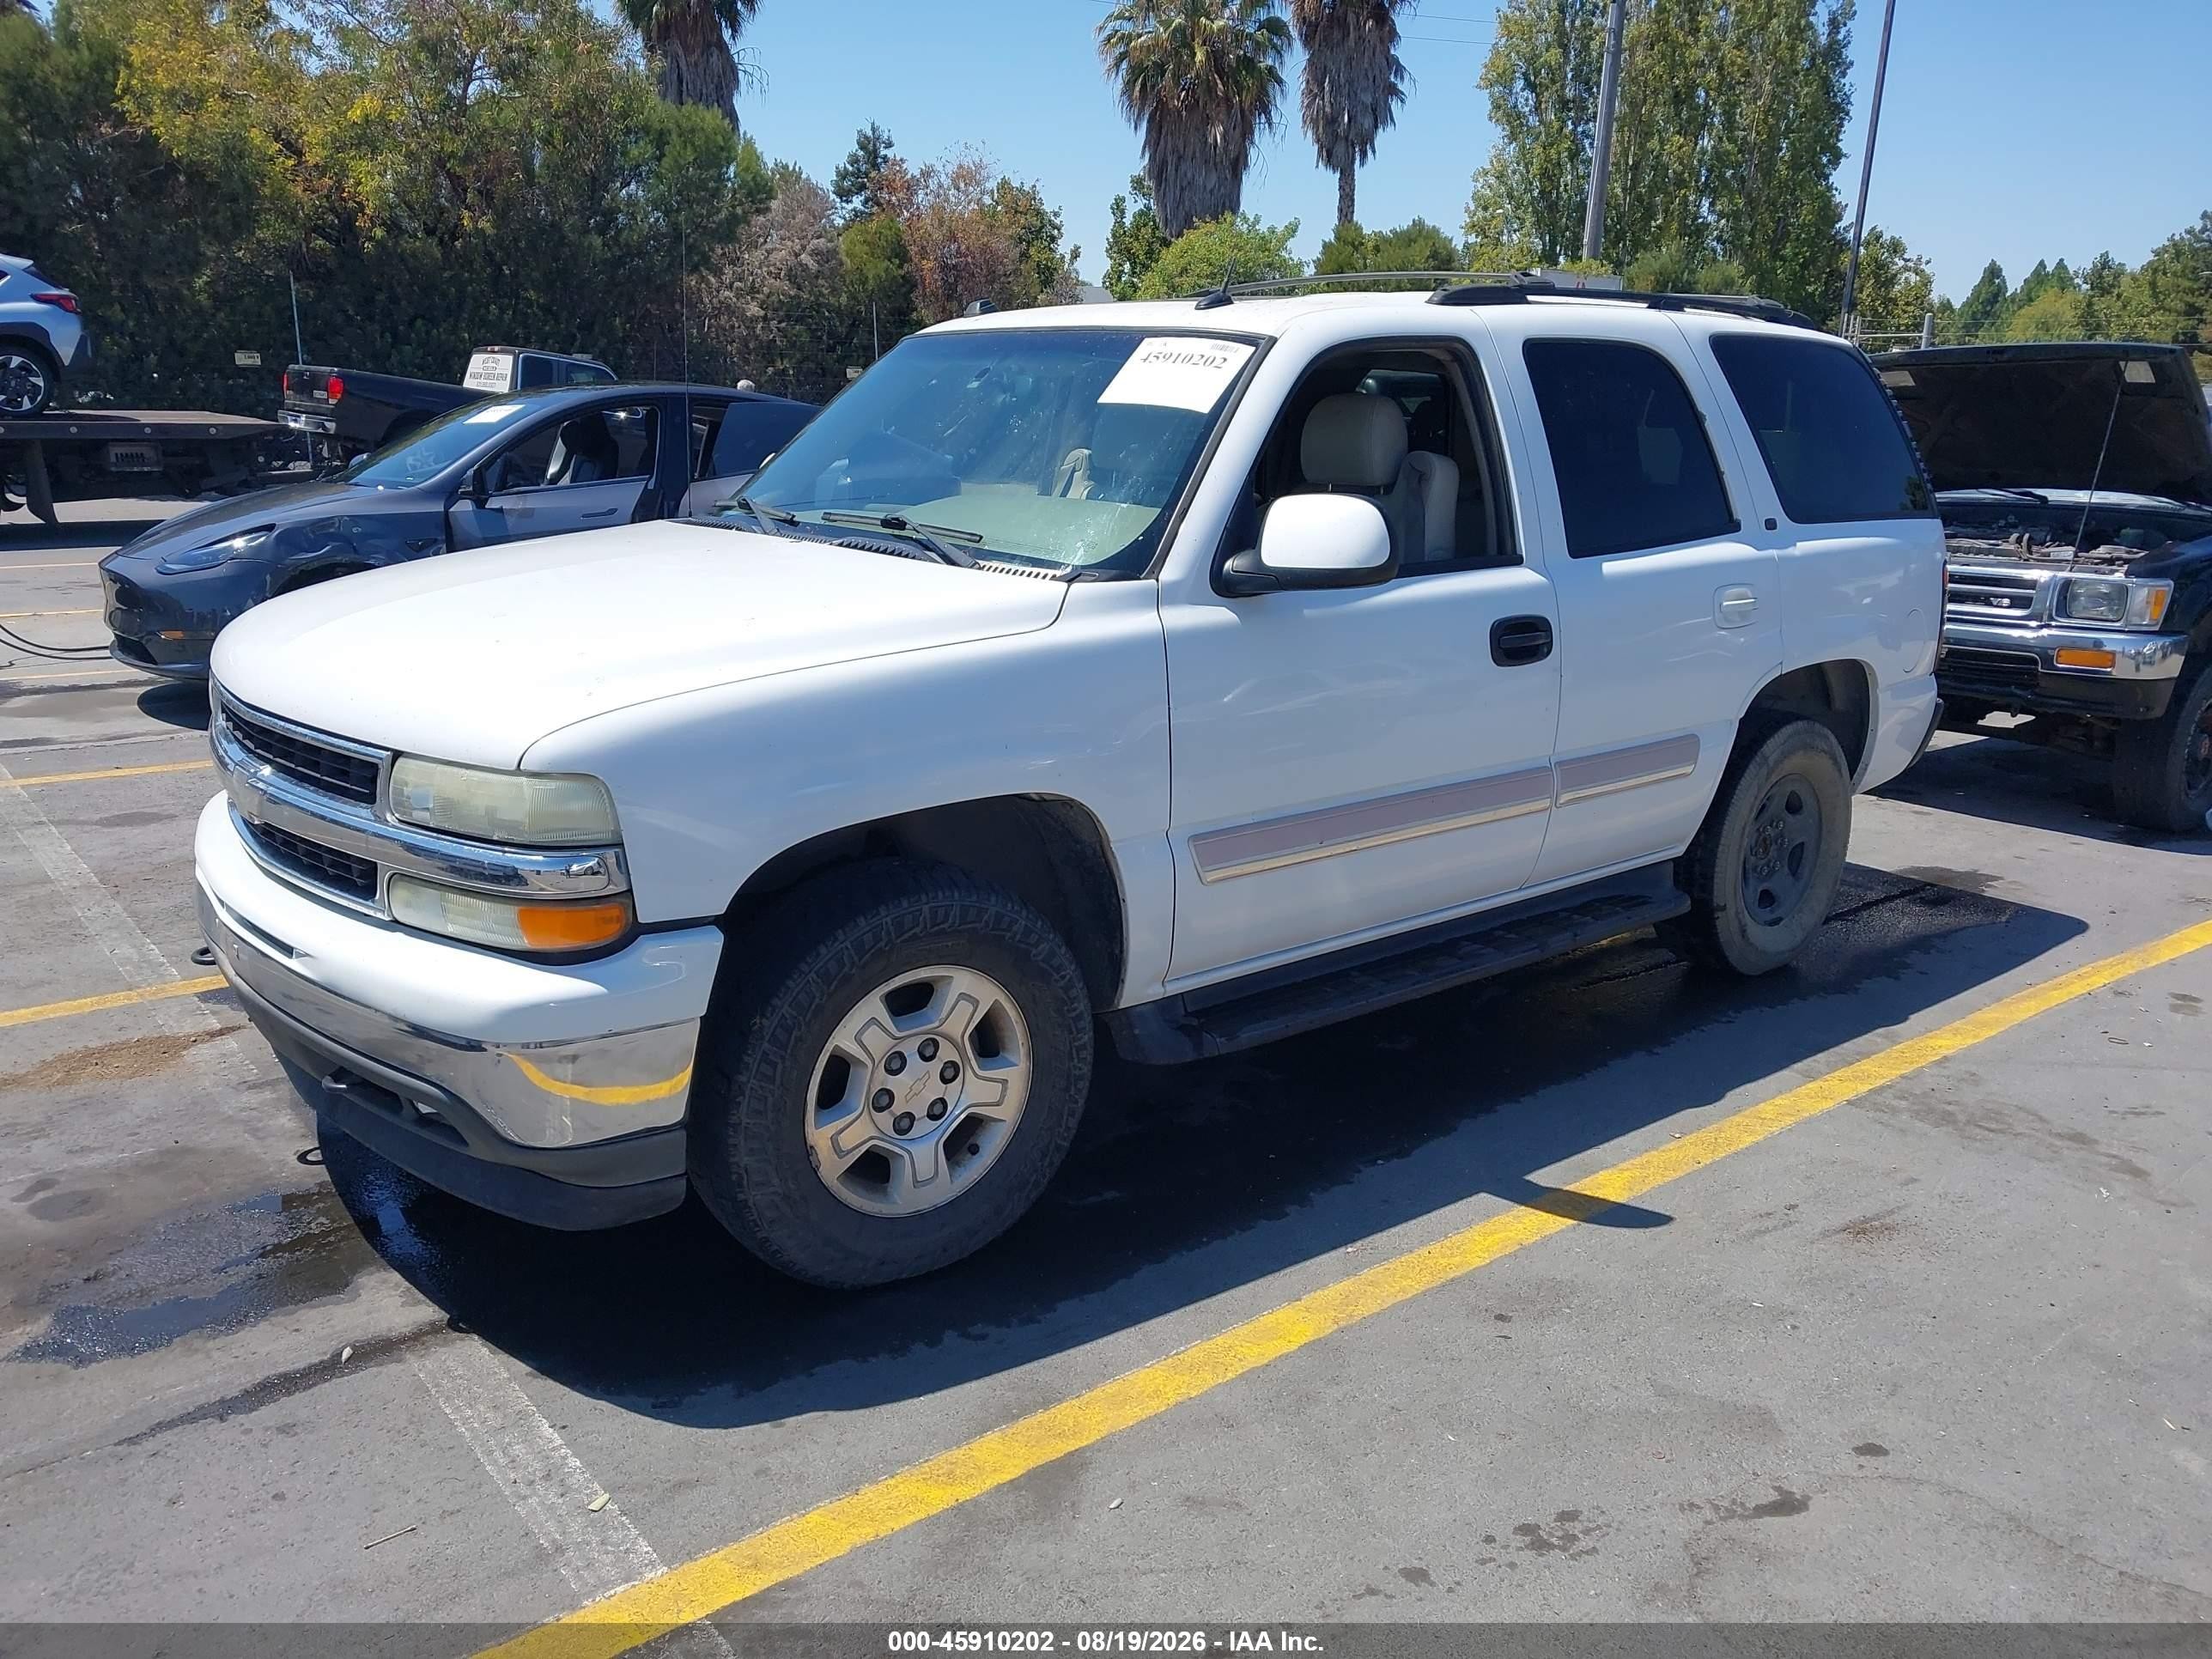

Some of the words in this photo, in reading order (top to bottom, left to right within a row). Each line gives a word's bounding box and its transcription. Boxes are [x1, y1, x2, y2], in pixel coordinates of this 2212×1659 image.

[1140, 352, 1228, 369] 45910202
[469, 371, 483, 380] WINDOW
[495, 372, 507, 381] REPAIR
[1989, 597, 2011, 606] V6
